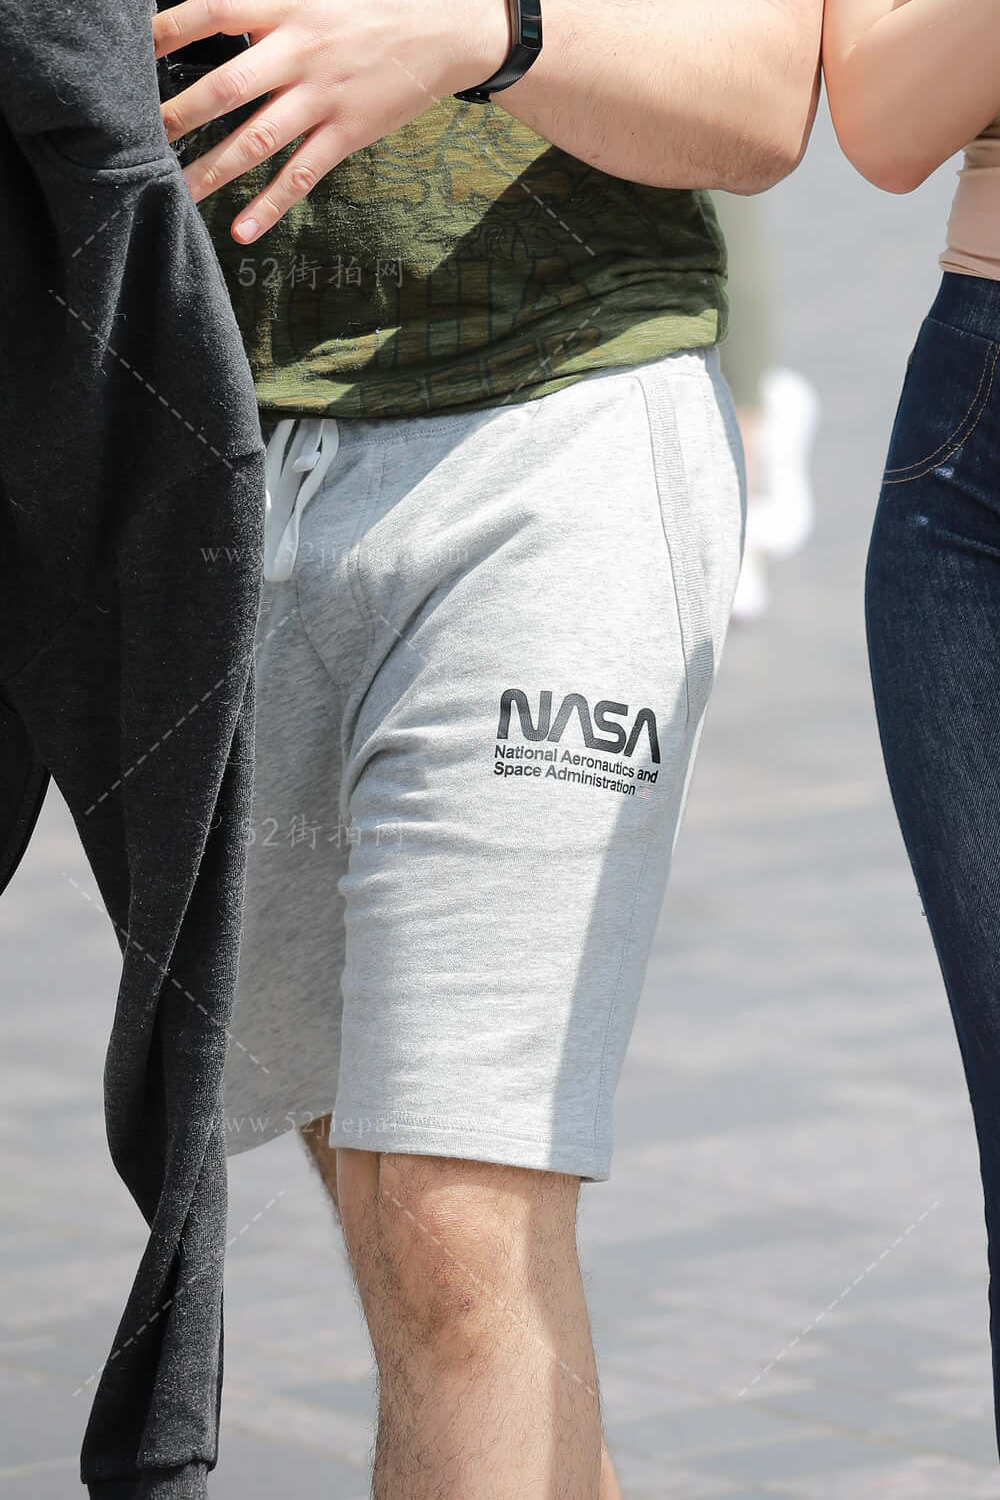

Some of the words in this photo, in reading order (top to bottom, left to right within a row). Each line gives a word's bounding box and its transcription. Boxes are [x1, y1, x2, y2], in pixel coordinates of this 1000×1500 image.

[496, 688, 661, 764] NASA
[493, 761, 542, 778] Space
[545, 765, 636, 796] Administration
[494, 744, 558, 763] National
[560, 750, 635, 778] Aeronautics
[638, 767, 659, 784] and
